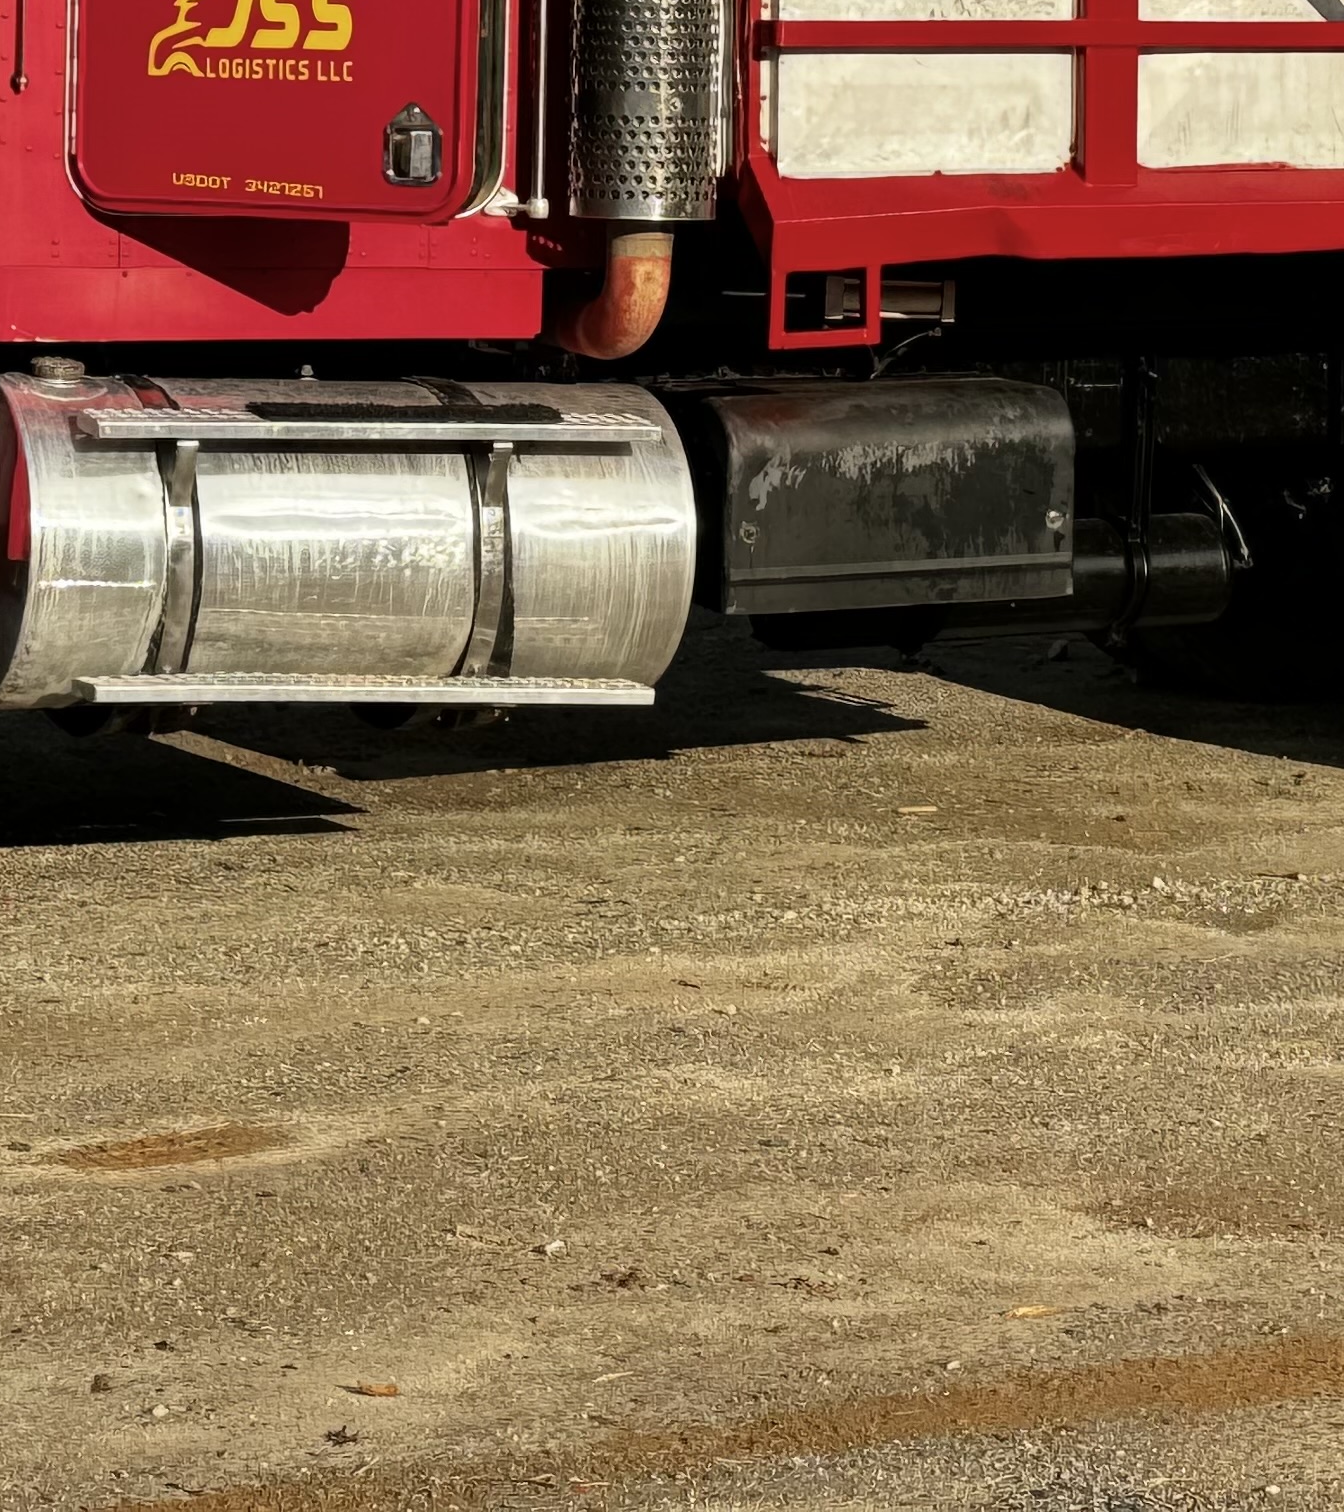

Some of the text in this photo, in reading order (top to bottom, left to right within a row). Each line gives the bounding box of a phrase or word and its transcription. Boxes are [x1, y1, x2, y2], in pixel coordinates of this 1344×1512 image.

[206, 57, 354, 82] LOGISTICS LLC
[172, 172, 232, 189] USDOT
